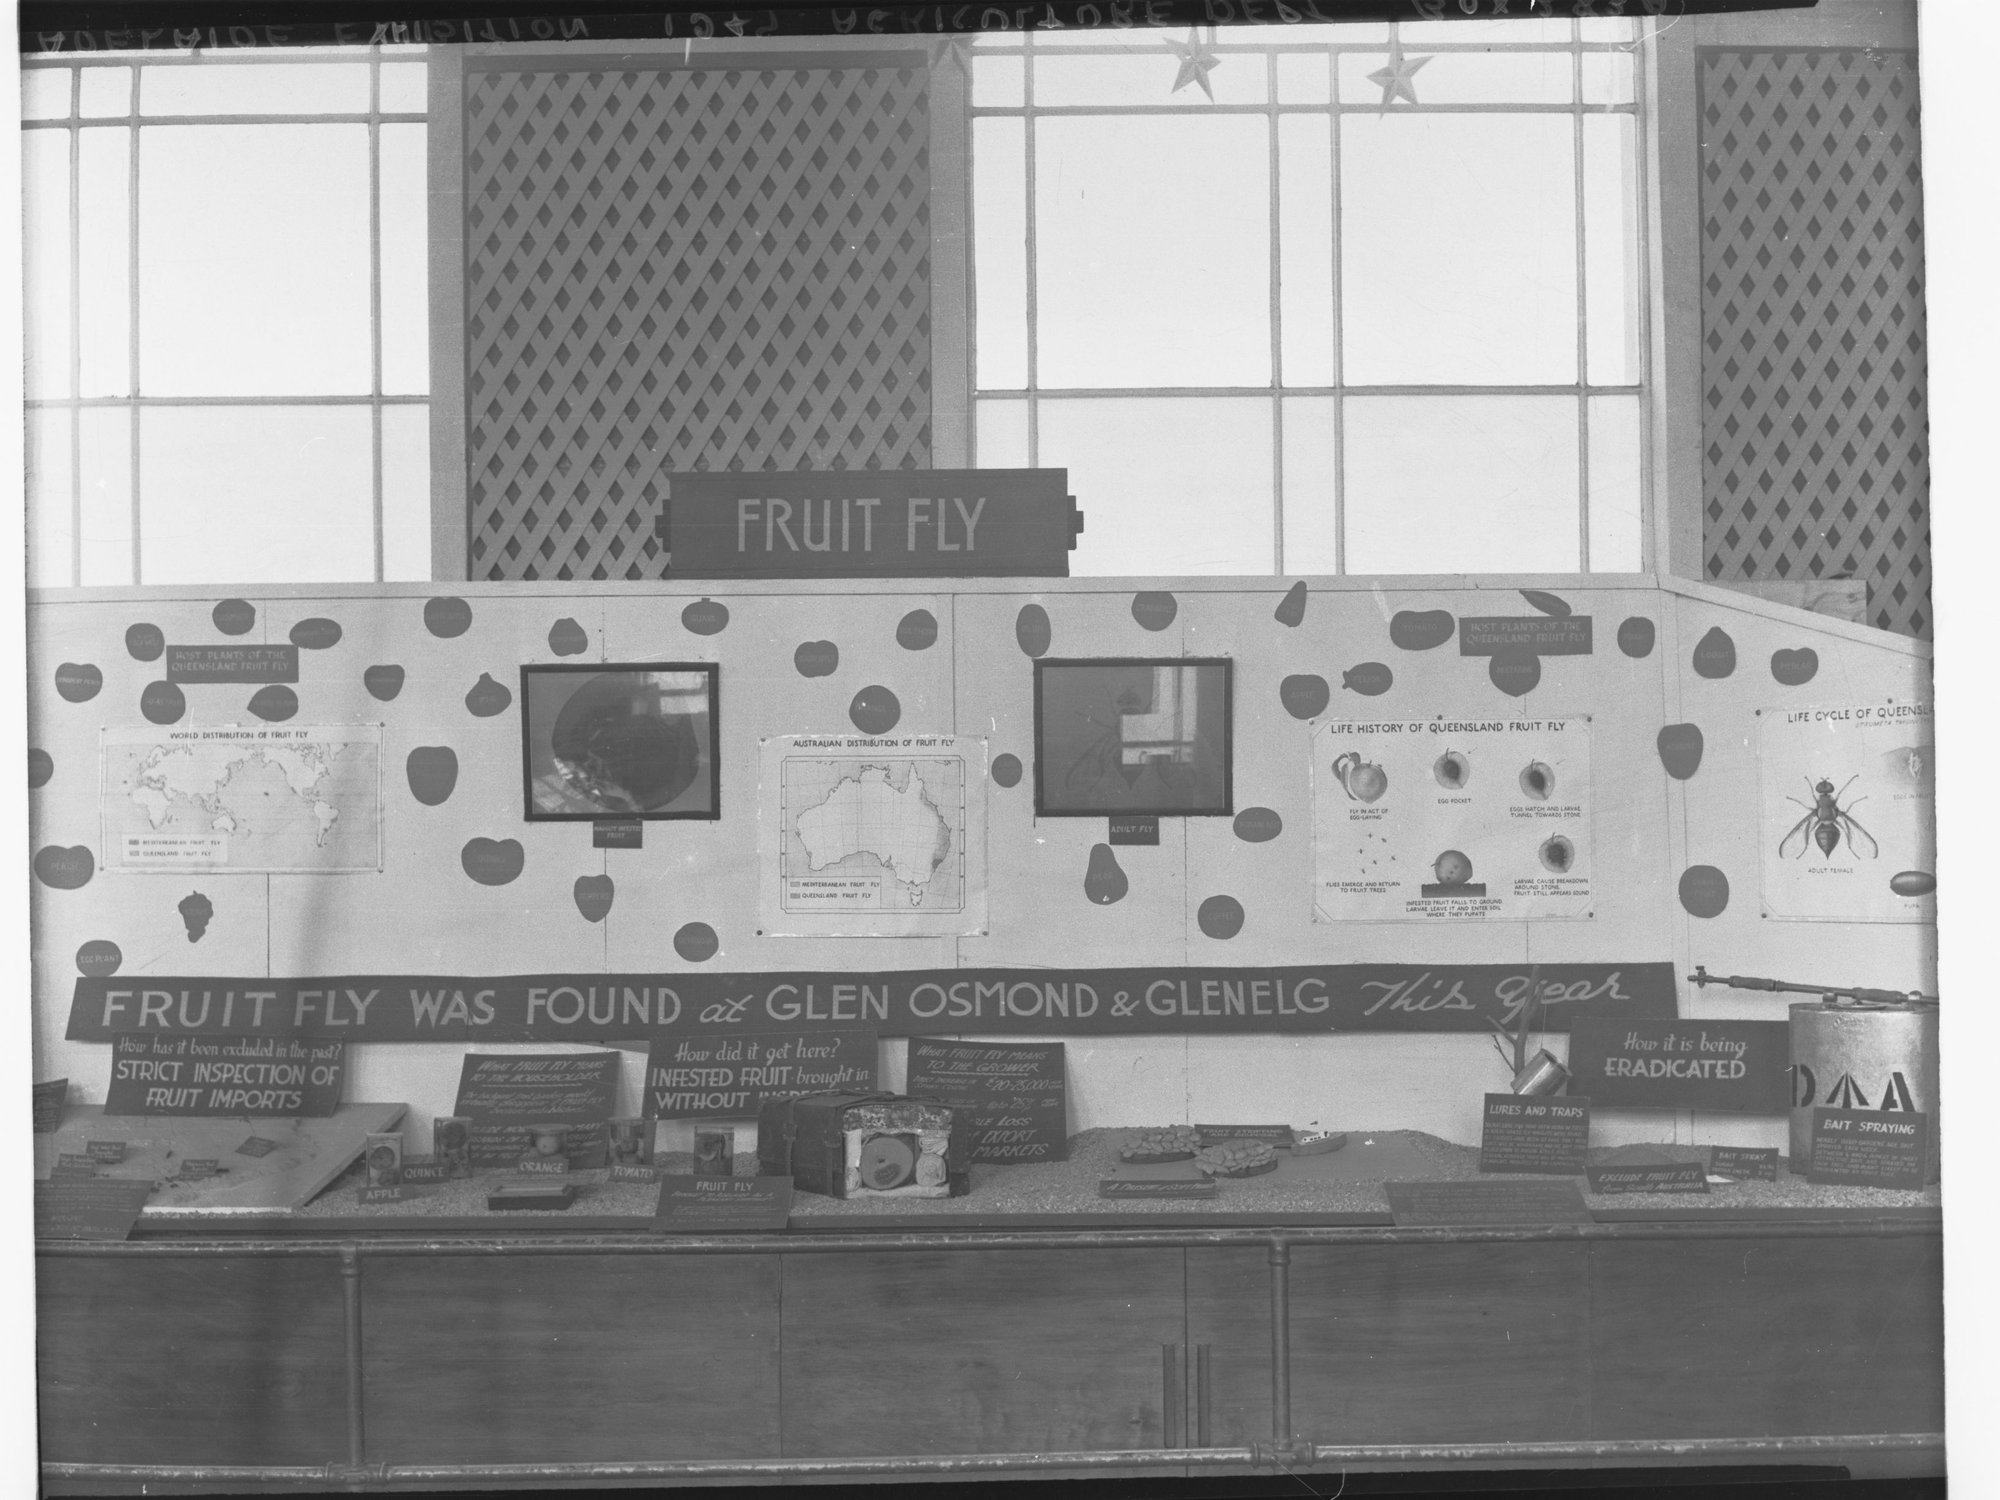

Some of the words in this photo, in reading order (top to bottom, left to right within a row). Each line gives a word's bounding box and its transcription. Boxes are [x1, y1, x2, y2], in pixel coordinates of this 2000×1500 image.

[737, 498, 882, 552] FRUIT
[907, 497, 986, 552] FLY
[1471, 622, 1497, 632] HOST
[1501, 622, 1540, 631] PLANTS
[1544, 622, 1558, 631] OF
[1563, 622, 1581, 631] THE
[1466, 634, 1531, 645] QUEENSLAND
[1536, 633, 1565, 642] FRUIT
[1568, 632, 1586, 642] FLY
[176, 651, 202, 660] HOST
[207, 651, 244, 660] PLANTS
[248, 651, 261, 660] OF
[266, 650, 286, 660] THE
[171, 661, 237, 672] QUEENSLAND
[240, 662, 269, 671] FRUIT
[272, 662, 288, 671] FLY
[1788, 712, 1810, 723] LIFE
[1815, 709, 1850, 722] CYCLE
[1856, 708, 1874, 719] OF
[1331, 723, 1353, 734] LIFE
[1357, 723, 1403, 734] HISTORY
[1409, 723, 1424, 733] OF
[1429, 722, 1503, 735] QUEENSLAND
[1509, 721, 1542, 732] FRUIT
[1547, 721, 1566, 732] FLY
[170, 731, 199, 740] WORLD
[202, 731, 254, 740] DISTRIBUTION
[257, 731, 267, 739] OF
[271, 731, 291, 739] FRUIT
[295, 731, 308, 739] FLY
[792, 739, 842, 747] AUSTRALIAN
[846, 739, 899, 747] DISTRIBUTION
[902, 739, 912, 747] OF
[915, 739, 938, 747] FRUIT
[941, 739, 955, 747] FLY
[1110, 825, 1137, 834] ADULT
[1138, 825, 1155, 834] FLY
[95, 954, 119, 963] PLANT
[101, 989, 279, 1028] FRUIT
[293, 988, 382, 1027] FLY
[409, 988, 497, 1029] WAS
[525, 986, 683, 1026] FOUND
[698, 993, 753, 1025] at
[764, 983, 890, 1022] GLEN
[908, 981, 1099, 1020] OSMOND
[1110, 990, 1139, 1018] &
[1144, 979, 1332, 1017] GLENELG
[1359, 972, 1477, 1018] This
[118, 1036, 147, 1052] How
[153, 1033, 174, 1055] has
[176, 1038, 187, 1055] it
[190, 1037, 219, 1056] been
[222, 1038, 273, 1057] excluded
[275, 1041, 287, 1057] in
[290, 1041, 308, 1058] the
[310, 1043, 343, 1063] past?
[675, 1040, 711, 1063] How
[715, 1040, 743, 1061] did
[747, 1041, 760, 1061] it
[765, 1042, 792, 1066] get
[796, 1037, 841, 1059] here?
[916, 1044, 948, 1057] WHAT
[948, 1047, 984, 1060] FRUIT
[983, 1049, 1008, 1060] FLY
[1007, 1051, 1049, 1060] MEANS
[1624, 1031, 1660, 1051] How
[1663, 1032, 1676, 1051] it
[1680, 1033, 1694, 1051] is
[1699, 1031, 1748, 1059] being
[116, 1060, 185, 1082] STRICT
[193, 1062, 306, 1085] INSPECTION
[310, 1065, 340, 1086] OF
[926, 1060, 946, 1069] TO
[948, 1061, 975, 1071] THE
[976, 1062, 1040, 1073] GROWER
[1603, 1057, 1747, 1080] ERADICATED
[651, 1067, 734, 1088] INFESTED
[739, 1065, 793, 1087] FRUIT
[796, 1064, 854, 1089] brought
[855, 1067, 870, 1082] in
[1791, 1064, 1816, 1108] D
[145, 1088, 203, 1108] FRUIT
[208, 1089, 302, 1109] IMPORTS
[654, 1091, 751, 1111] WITHOUT
[1489, 1103, 1521, 1115] LURES
[1524, 1105, 1547, 1116] AND
[1551, 1106, 1585, 1118] TRAPS
[997, 1115, 1033, 1126] LOSS
[1823, 1119, 1852, 1130] BAIT
[1858, 1121, 1916, 1135] SPRAYING
[981, 1129, 1038, 1144] EXPORT
[971, 1143, 1049, 1157] MARKETS
[404, 1166, 444, 1179] QUINCE
[520, 1161, 564, 1174] ORANGE
[613, 1165, 654, 1179] TOMATO
[1646, 1172, 1676, 1181] FRUIT
[1678, 1170, 1699, 1180] FLY
[696, 1181, 729, 1192] FRUIT
[734, 1181, 754, 1192] FLY
[366, 1187, 401, 1201] APPLE
